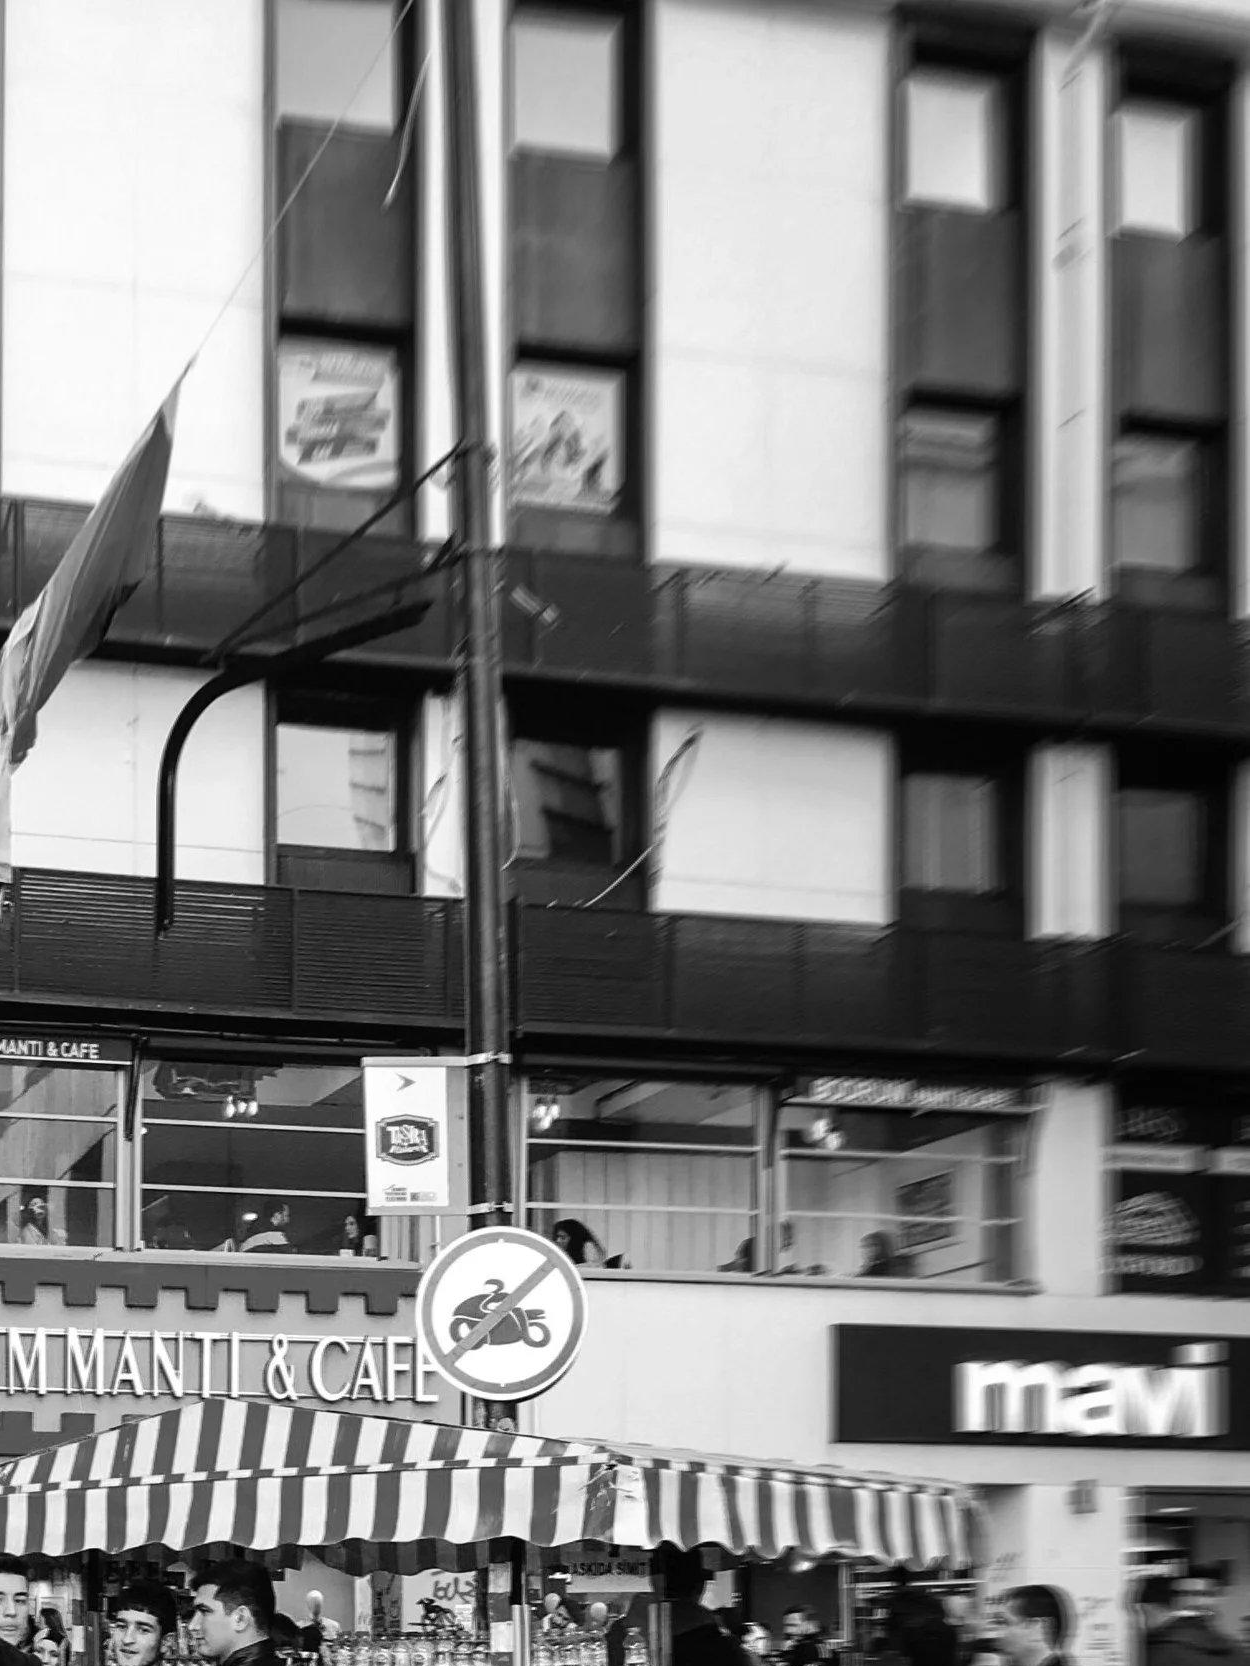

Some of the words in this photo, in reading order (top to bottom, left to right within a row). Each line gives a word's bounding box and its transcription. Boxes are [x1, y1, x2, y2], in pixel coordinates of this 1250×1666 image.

[47, 1041, 59, 1057] &
[61, 1042, 101, 1060] CAFE
[64, 1326, 241, 1399] MANTI
[266, 1332, 296, 1399] &
[310, 1333, 440, 1402] CAFE
[952, 1341, 1230, 1438] mavi
